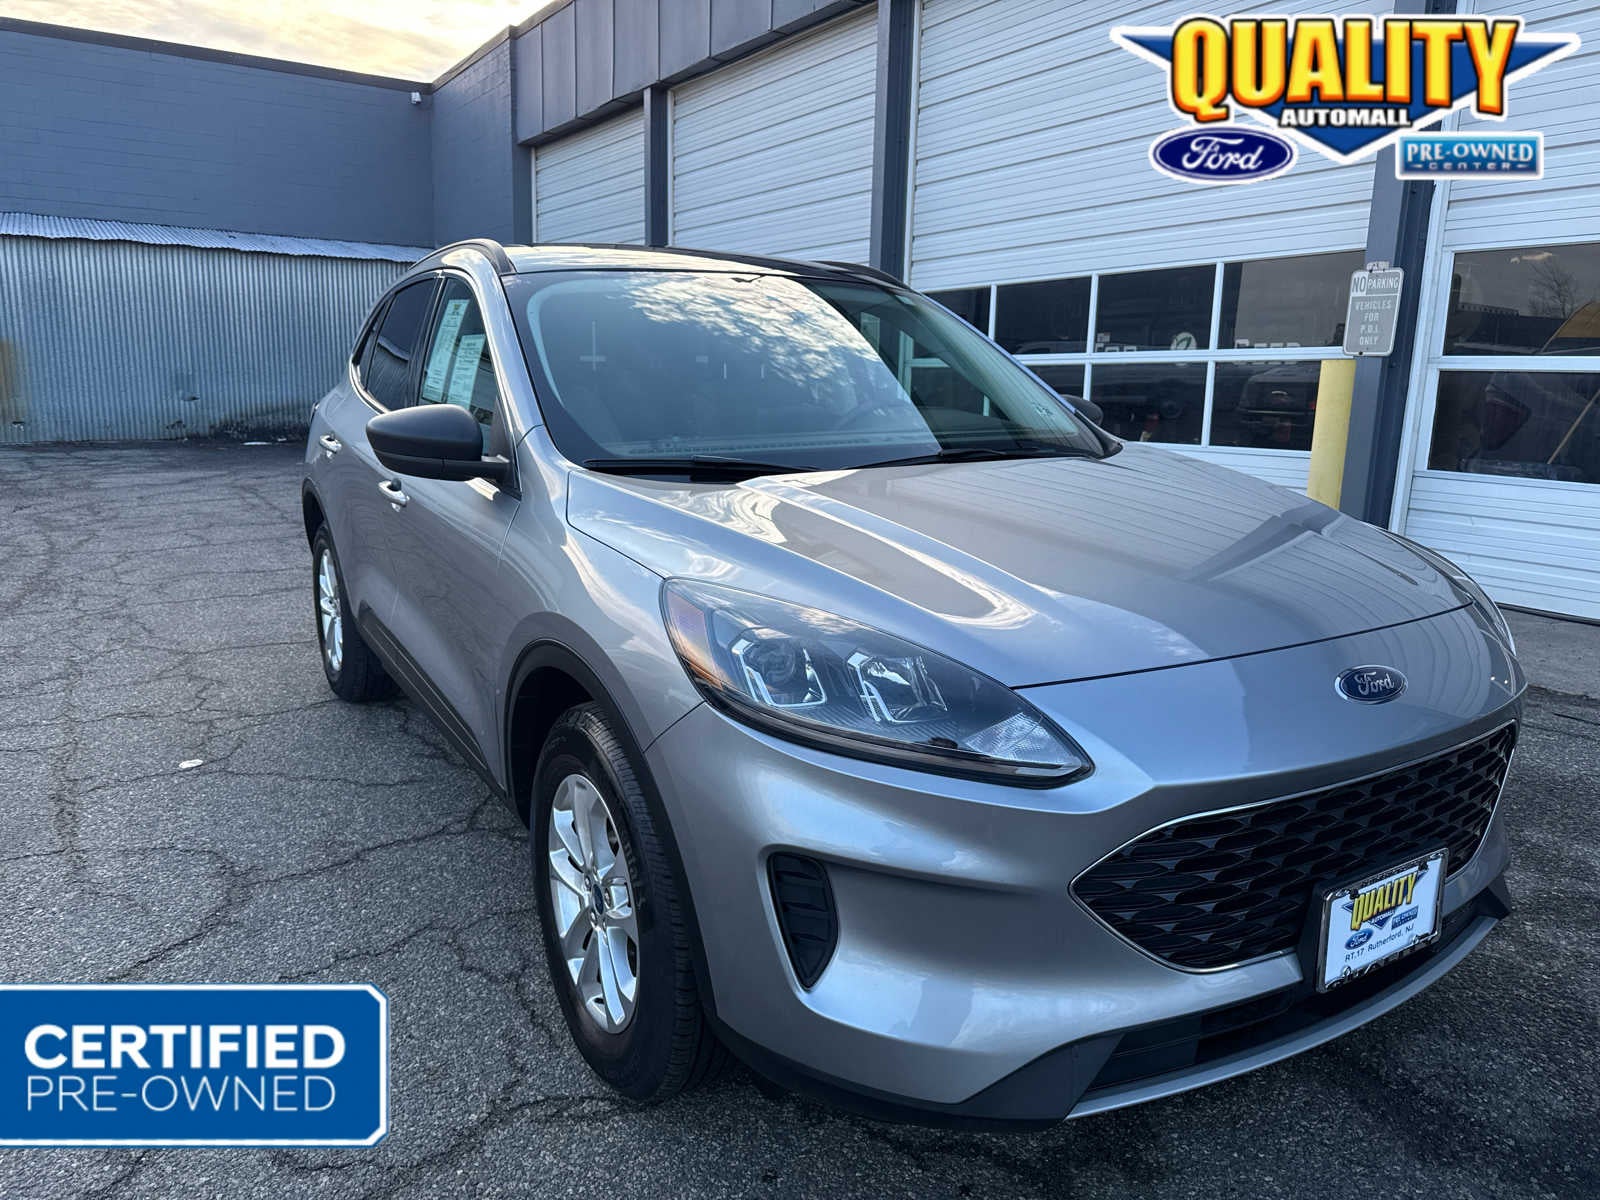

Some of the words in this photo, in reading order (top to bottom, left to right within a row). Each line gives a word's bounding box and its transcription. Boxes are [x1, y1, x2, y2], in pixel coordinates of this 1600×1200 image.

[1352, 276, 1366, 293] NO
[1367, 276, 1399, 289] PARKING
[1355, 300, 1391, 310] VEHICLES
[1364, 312, 1379, 321] FOR
[1360, 335, 1378, 345] ONLY
[1354, 672, 1394, 695] Ford
[1351, 871, 1419, 931] QUALITY
[1405, 923, 1415, 933] NJ
